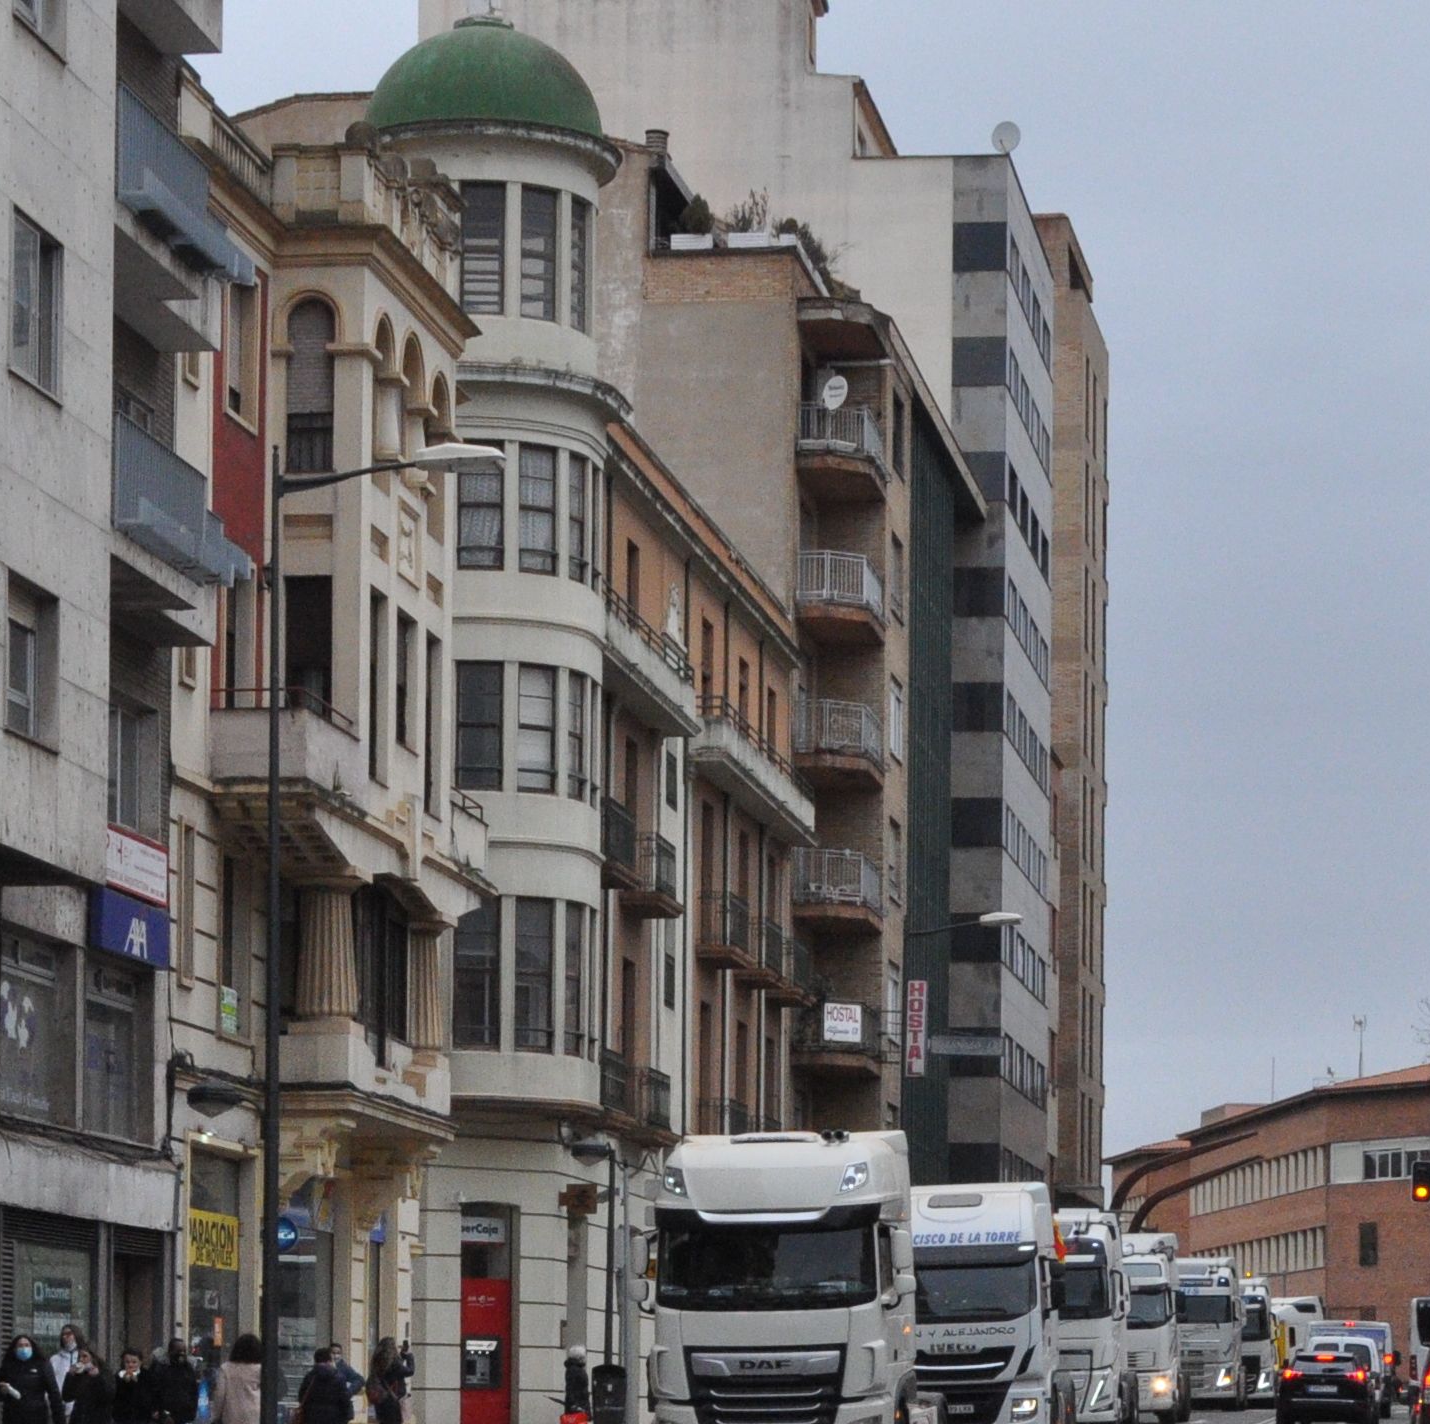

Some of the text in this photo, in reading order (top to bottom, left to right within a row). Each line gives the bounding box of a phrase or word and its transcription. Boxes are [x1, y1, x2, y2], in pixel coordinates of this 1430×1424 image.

[124, 918, 148, 960] AXA
[826, 1006, 859, 1023] HOSTAL
[908, 982, 924, 1075] HOSTAL
[913, 1231, 1021, 1245] CISCO DE LA TORRE
[195, 1246, 204, 1261] DE
[928, 1329, 937, 1338] Y
[943, 1326, 1016, 1337] ALEJANDRO
[930, 1343, 976, 1353] IVECO
[738, 1359, 792, 1370] DAF
